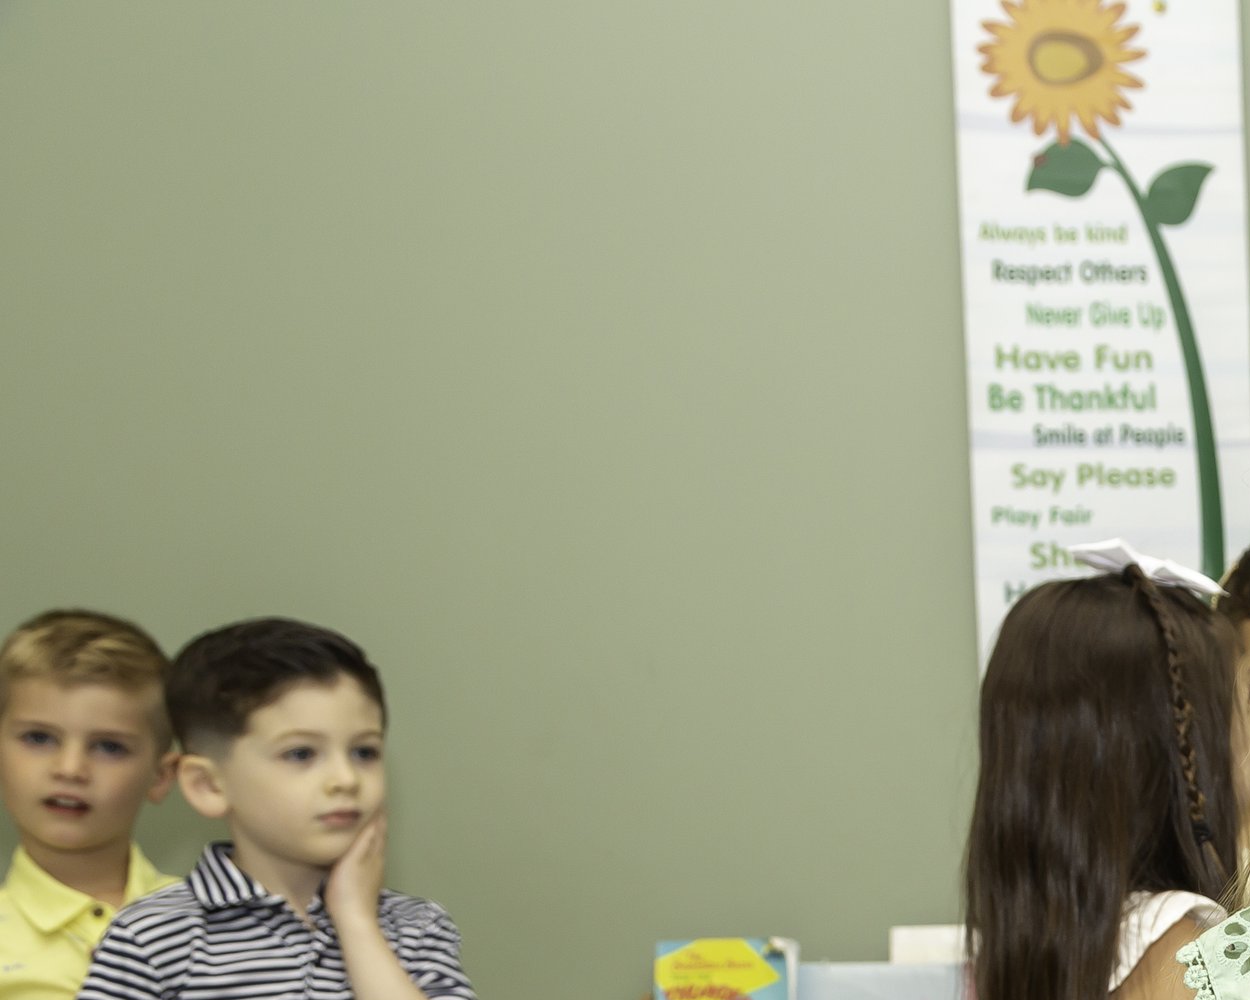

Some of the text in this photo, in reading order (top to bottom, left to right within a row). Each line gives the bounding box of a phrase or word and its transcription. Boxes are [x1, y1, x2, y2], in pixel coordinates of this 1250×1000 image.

[978, 222, 1047, 247] Always
[1053, 222, 1078, 243] be
[991, 258, 1148, 285] Respect Others
[1025, 301, 1167, 331] Never Give Up
[994, 345, 1154, 371] Have Fun
[987, 382, 1157, 412] Be Thankful
[1032, 424, 1187, 451] Smile at People
[1010, 463, 1177, 494] Say Please
[991, 505, 1093, 529] Play Fair
